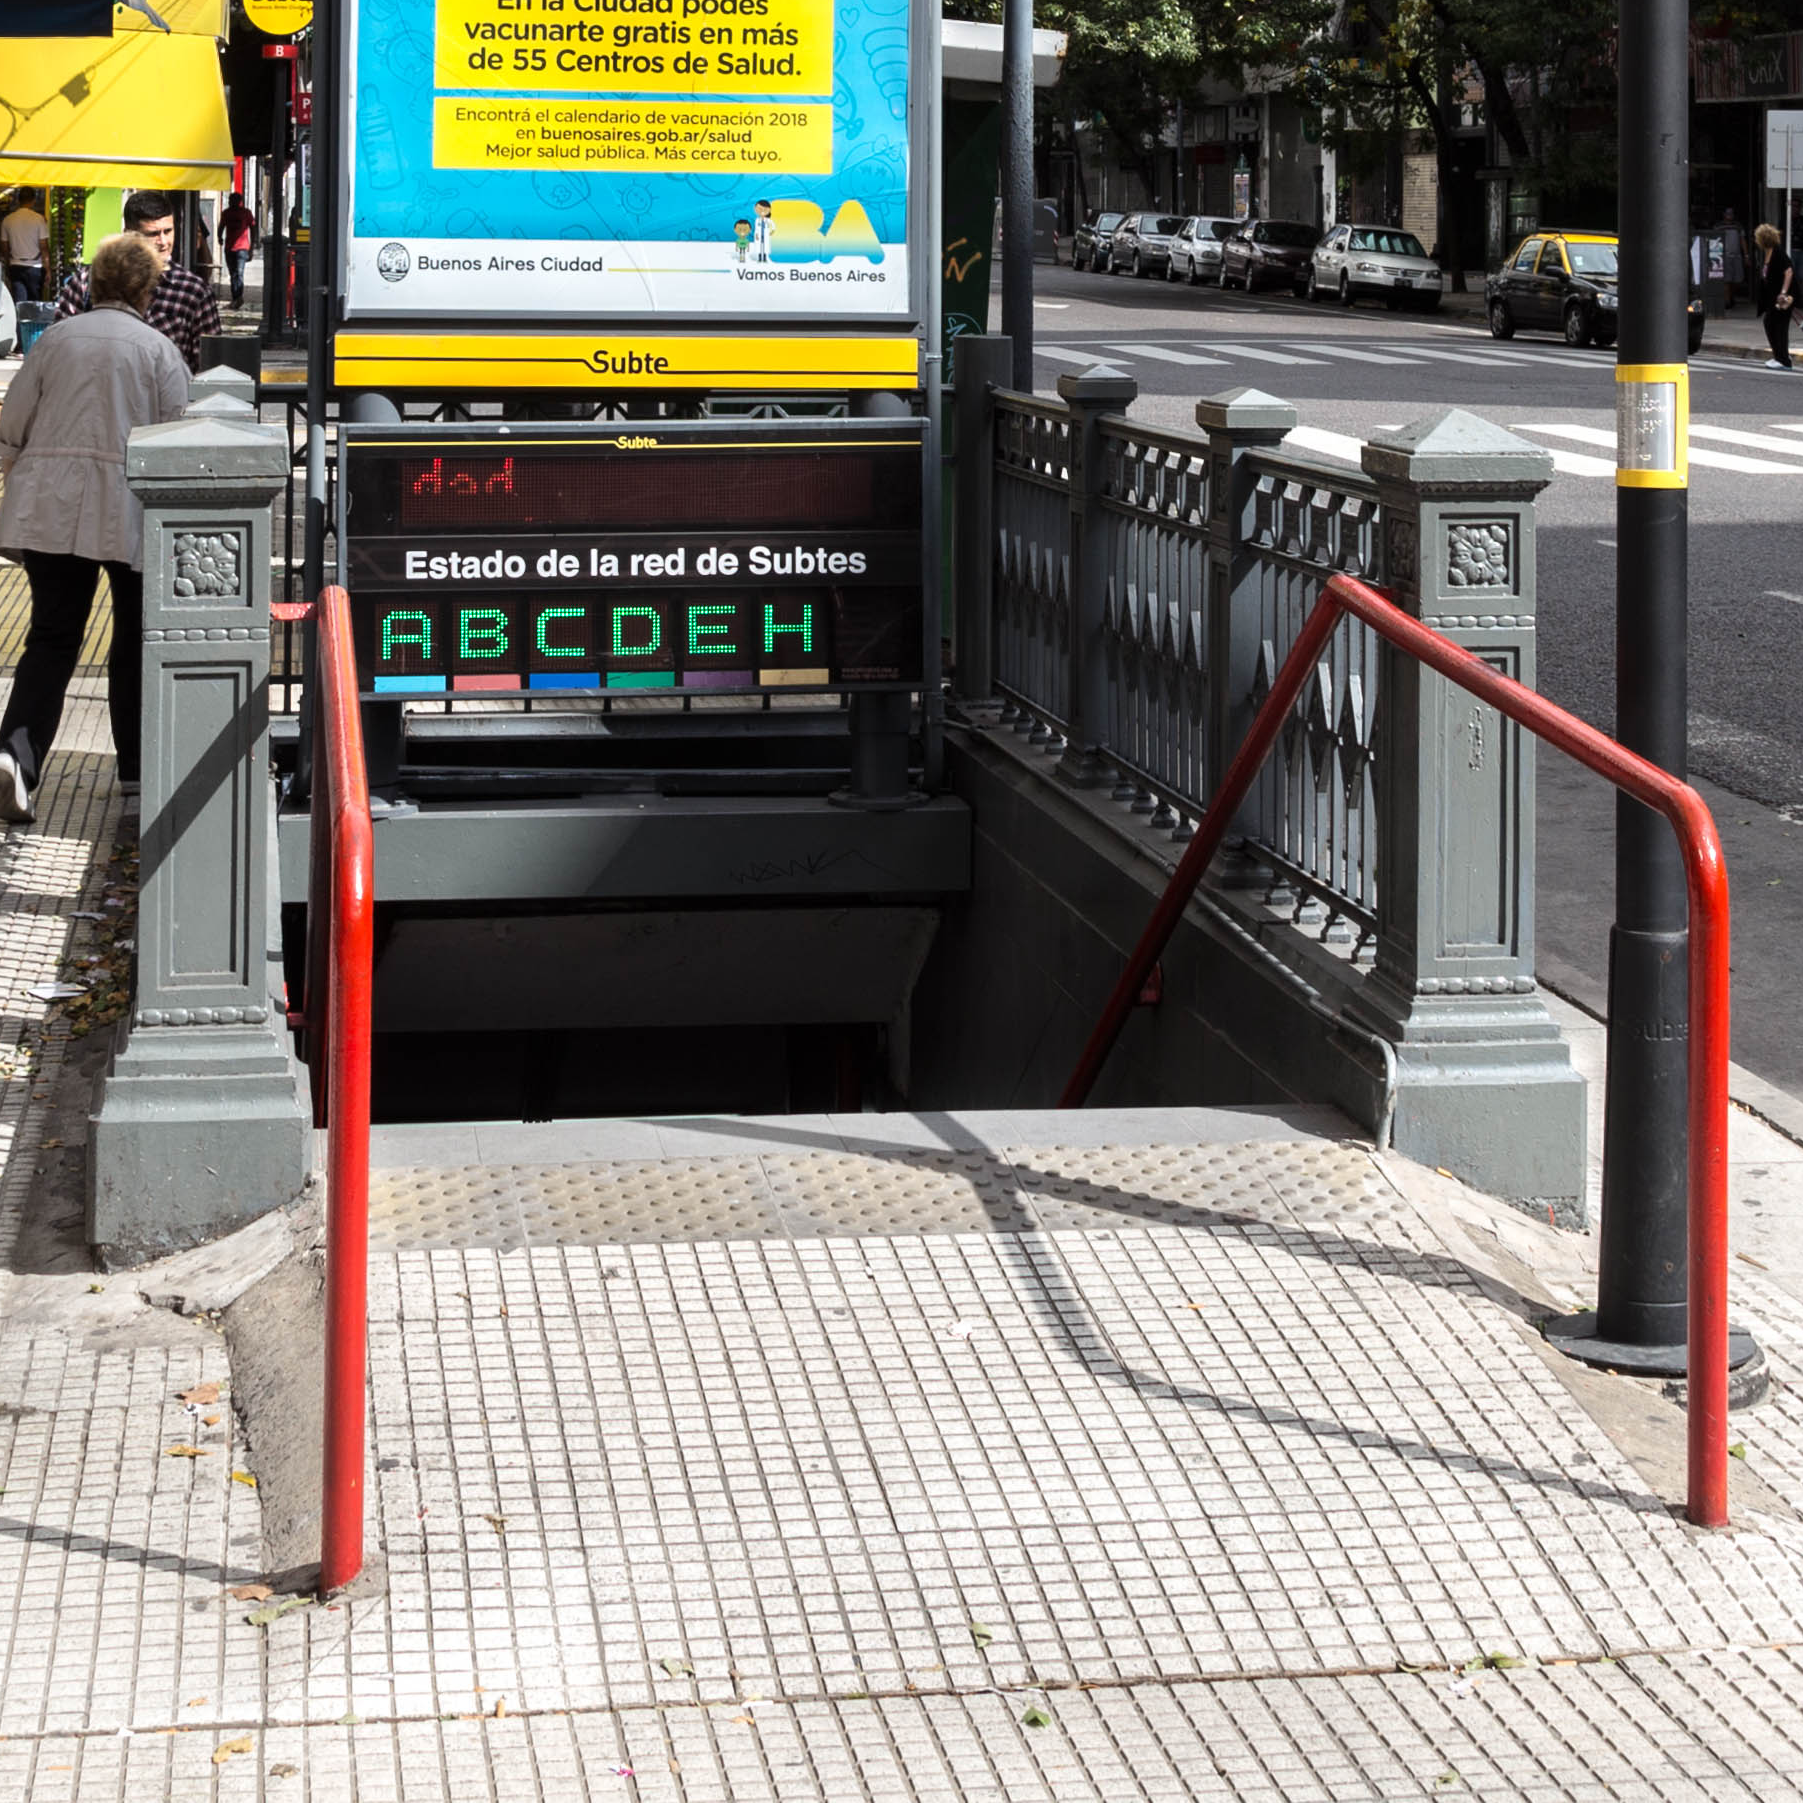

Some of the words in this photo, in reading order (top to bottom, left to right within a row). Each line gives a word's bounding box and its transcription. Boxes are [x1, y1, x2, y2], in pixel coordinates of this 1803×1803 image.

[464, 19, 605, 46] vacunarte
[612, 21, 691, 53] gratis
[699, 27, 734, 46] en
[741, 22, 799, 47] más
[275, 46, 284, 57] B
[467, 47, 504, 73] de
[512, 49, 547, 73] 55
[555, 49, 665, 75] Centros
[672, 50, 709, 76] de
[716, 51, 802, 77] Salud.
[455, 107, 531, 125] Encontrá
[535, 108, 551, 125] el
[554, 108, 641, 126] calendario
[645, 109, 667, 126] de
[671, 109, 765, 127] vacunación
[768, 111, 808, 127] 2018
[516, 129, 536, 142] en
[540, 126, 753, 146] buenosaires.gob.ar/salud
[485, 144, 532, 162] Mejor
[537, 144, 582, 159] salud
[585, 144, 650, 164] pública.
[654, 144, 686, 162] Más
[690, 149, 737, 163] cerca
[740, 148, 783, 166] tuyo.
[417, 255, 484, 273] Buenos
[488, 255, 536, 273] Aires
[540, 255, 604, 273] Ciudad
[736, 267, 786, 283] Vamos
[790, 268, 843, 283] Buenos
[846, 268, 887, 284] Aires
[590, 349, 670, 376] Subte
[617, 436, 658, 449] Subte
[405, 549, 527, 580] Estado
[536, 548, 580, 578] de
[589, 548, 620, 577] la
[630, 547, 686, 577] red
[696, 547, 739, 576] de
[748, 545, 867, 575] Subtes
[382, 610, 432, 660] A
[459, 608, 509, 659] B
[536, 607, 586, 657] C
[612, 606, 661, 656] D
[687, 605, 737, 654] E
[764, 604, 812, 653] H
